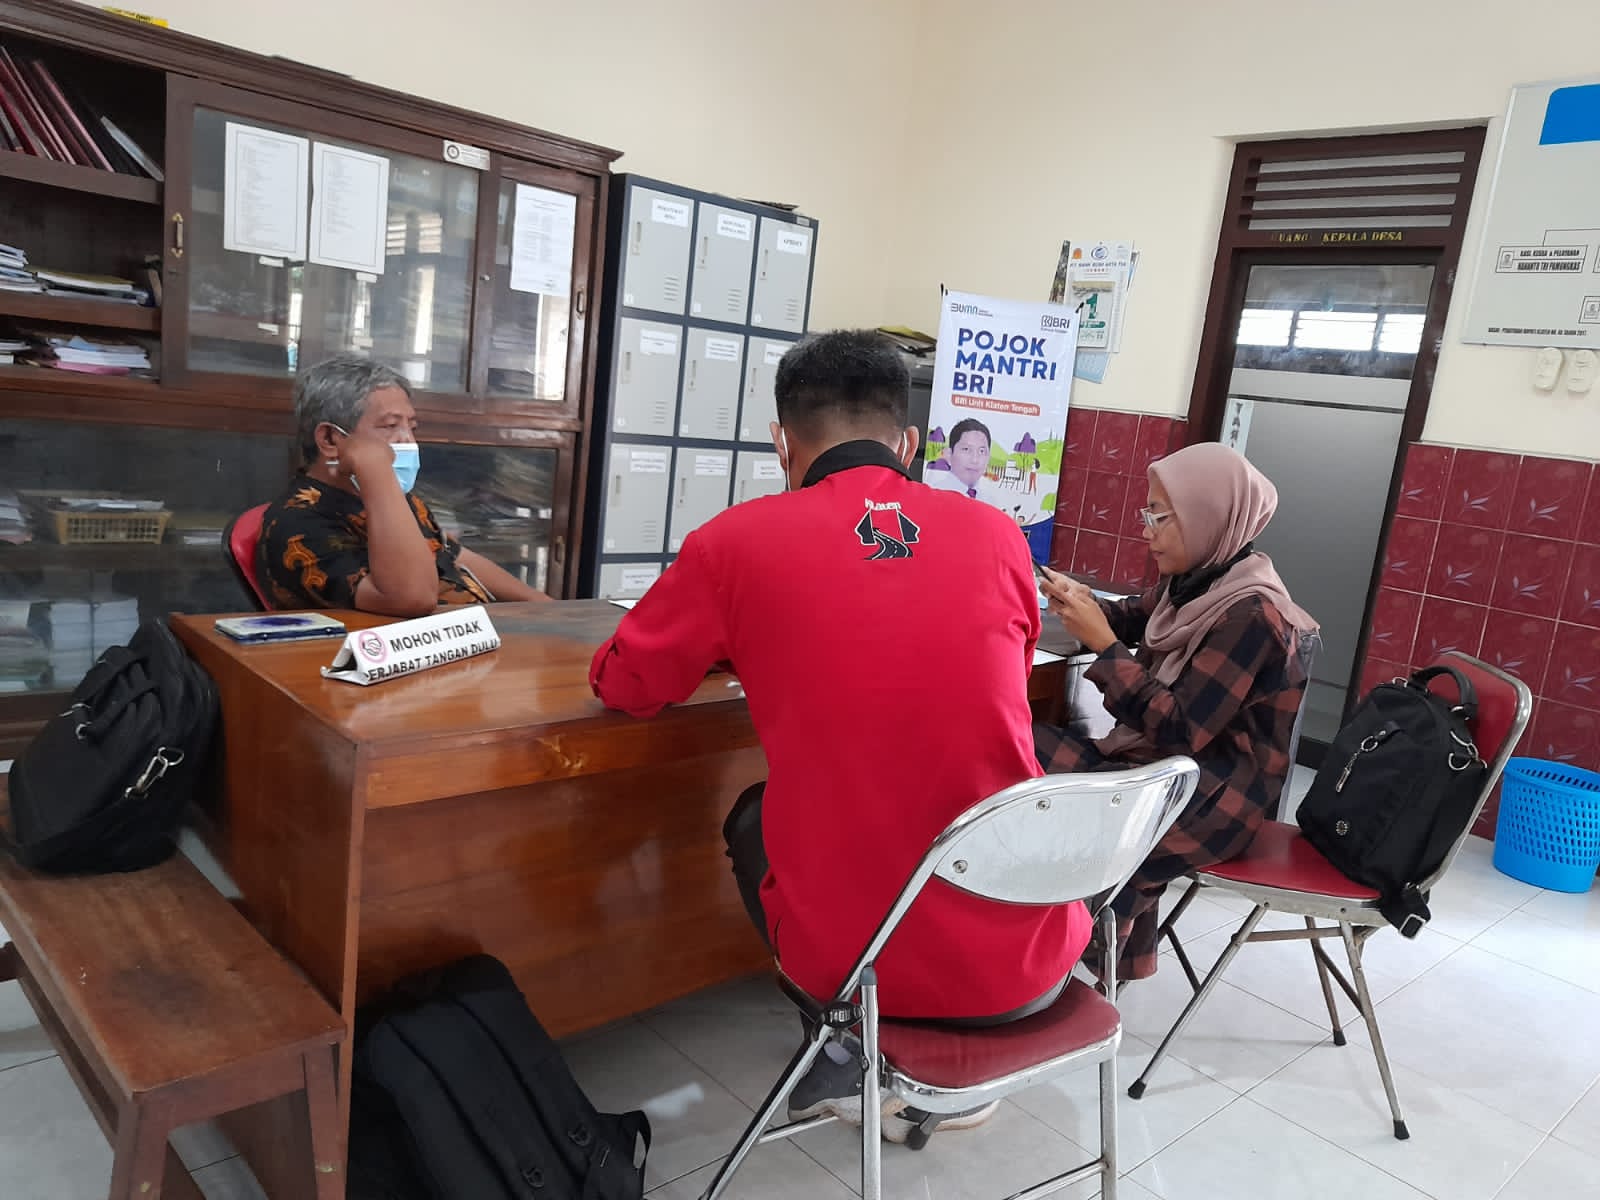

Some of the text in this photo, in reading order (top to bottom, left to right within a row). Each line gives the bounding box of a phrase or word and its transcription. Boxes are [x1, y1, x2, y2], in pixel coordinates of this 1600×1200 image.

[1273, 231, 1403, 242] UANG KEPALA DESA
[957, 327, 1047, 357] POJOK
[954, 349, 1057, 381] MANTRI
[952, 371, 994, 395] BRI
[985, 400, 1009, 410] Klaten
[1011, 403, 1038, 416] Tengah
[389, 620, 483, 653] MOHON TIDAK
[365, 639, 498, 681] ERJABAT TANGAN DULU
